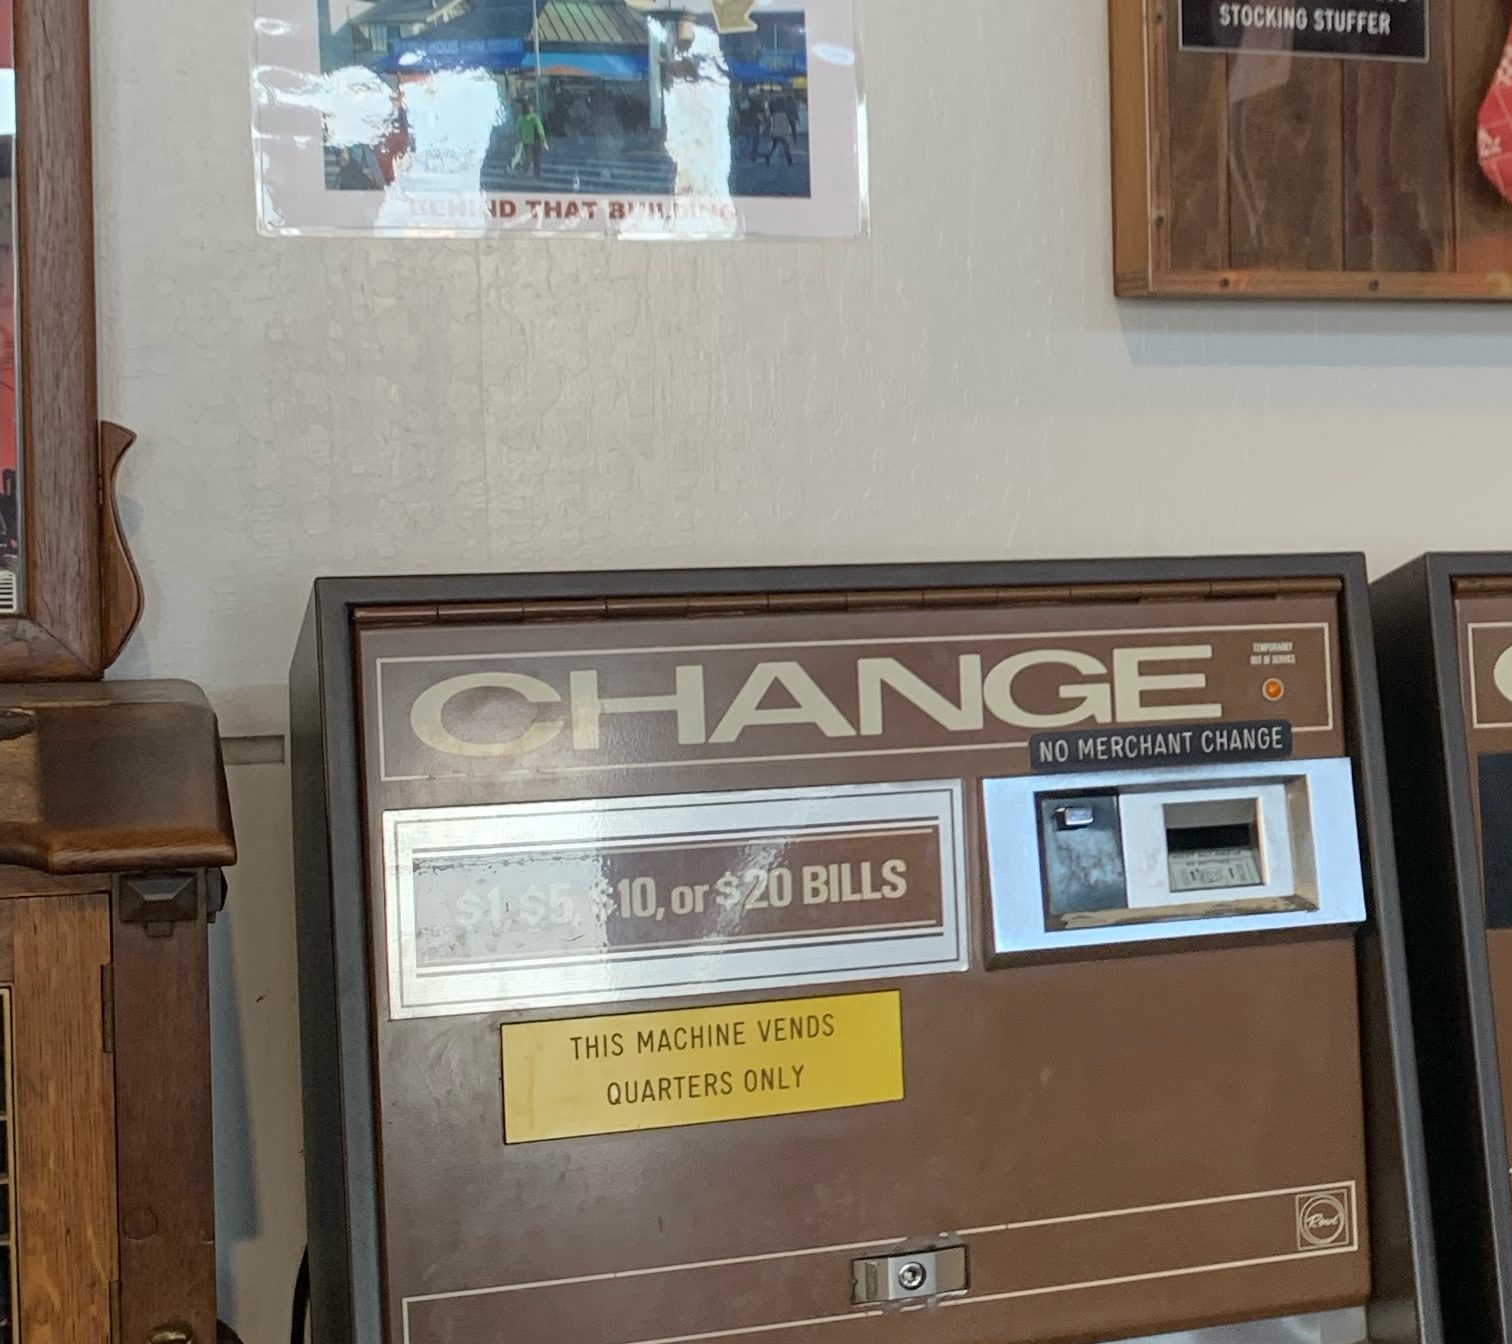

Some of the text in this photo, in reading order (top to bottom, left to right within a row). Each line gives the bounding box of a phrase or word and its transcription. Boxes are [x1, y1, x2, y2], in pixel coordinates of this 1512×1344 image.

[1219, 2, 1392, 36] STOCKING STUFFER
[525, 199, 599, 220] THAT
[410, 643, 1222, 757] CHANGE
[1039, 726, 1284, 763] NO MERCHANT CHANGE
[671, 886, 709, 916] or
[715, 866, 793, 912] $20
[803, 858, 908, 906] BILLS
[570, 1012, 836, 1061] THIS MACHINE VENDS
[606, 1064, 806, 1106] QUARTERS ONLY
